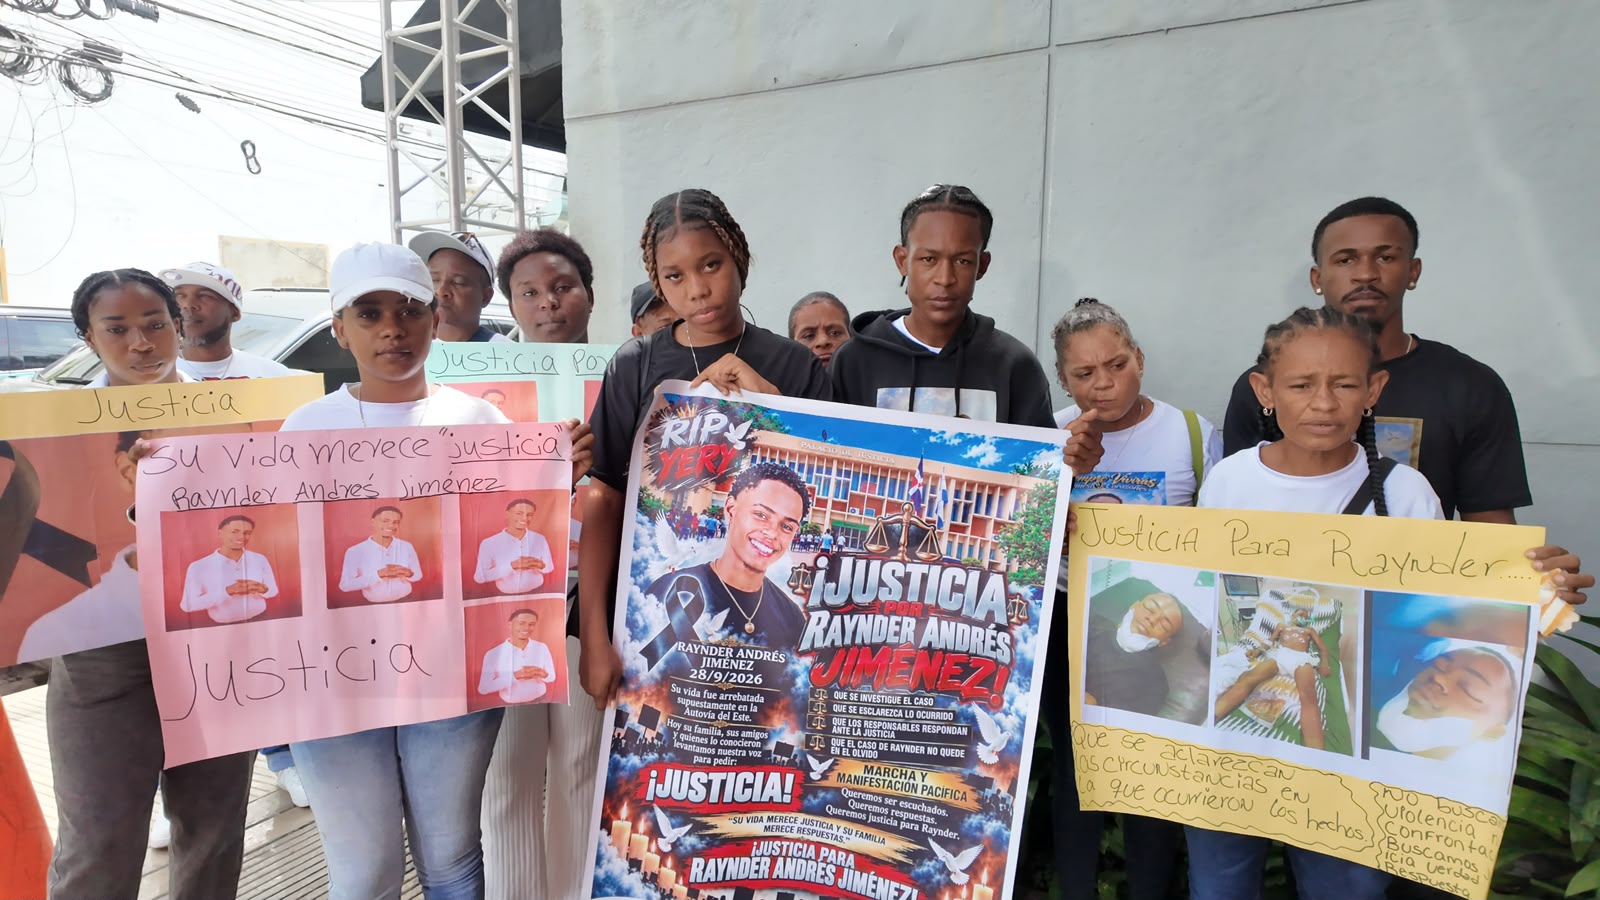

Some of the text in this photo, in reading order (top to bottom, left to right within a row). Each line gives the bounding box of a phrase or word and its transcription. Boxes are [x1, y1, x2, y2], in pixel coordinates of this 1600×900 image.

[78, 389, 242, 423] Justicia
[660, 411, 729, 449] RIP
[308, 437, 433, 464] merece
[801, 441, 838, 455] PALACIO
[841, 449, 852, 457] DE
[656, 442, 738, 485] YERY
[171, 485, 278, 510] Raynder
[295, 473, 379, 501] Andrés
[1224, 518, 1291, 558] Para
[806, 556, 1009, 626] ¡JUSTICIA
[883, 601, 924, 617] POR
[798, 610, 1012, 665] RAYNDER ANDRÉS
[677, 642, 786, 663] RAYNDER ANDRÉS
[701, 655, 755, 671] JIMÉNEZ
[163, 638, 432, 721] Justicia
[689, 669, 763, 685] 28/9/2026
[809, 643, 1010, 711] JIMÉNEZ!
[671, 683, 765, 703] Su vida fue arrebatada
[677, 696, 758, 712] supuestamente en la
[834, 691, 934, 707] QUE SE INVESTIGUE EL CASO
[684, 707, 752, 722] Autovía del Este.
[833, 703, 954, 721] QUE SE ESCLAREZCA LO OCURRIDO
[667, 718, 769, 740] Hoy su familia, sus amigos
[832, 717, 968, 736] QUE LOS RESPONSABLES RESPONDAN
[832, 726, 896, 739] ANTE LA JUSTICIA
[673, 739, 762, 758] levantamos nuestra voz
[680, 733, 709, 745] quienes
[710, 735, 718, 745] lo
[720, 736, 761, 748] conocieron
[831, 737, 965, 759] QUE EL CASO DE RAYNDER NO QUEDE
[1073, 725, 1109, 749] Que
[1121, 734, 1146, 751] se
[693, 754, 737, 767] para pedir:
[831, 746, 878, 759] EN EL OLVIDO
[863, 764, 928, 783] MARCHA Y
[646, 768, 796, 804] ¡JUSTICIA!
[920, 784, 968, 802] PACÍFICA
[841, 787, 949, 817] Queremos ser escuchados.
[848, 799, 938, 825] Queremos respuestas.
[1110, 778, 1146, 800] que
[1307, 808, 1368, 842] hechos.
[746, 815, 764, 824] VIDA
[766, 815, 799, 825] MERECE
[800, 818, 834, 832] JUSTICIA
[836, 823, 842, 832] Y
[843, 826, 854, 836] SU
[854, 829, 886, 845] FAMILIA
[763, 824, 795, 834] MERECE
[825, 804, 960, 840] Queremos justicia para Raynder.
[750, 841, 855, 868] ¡JUSTICIA PARA
[1386, 836, 1479, 872] Buscamos
[689, 857, 770, 883] RAYNDER
[771, 856, 836, 887] ANDRÉS
